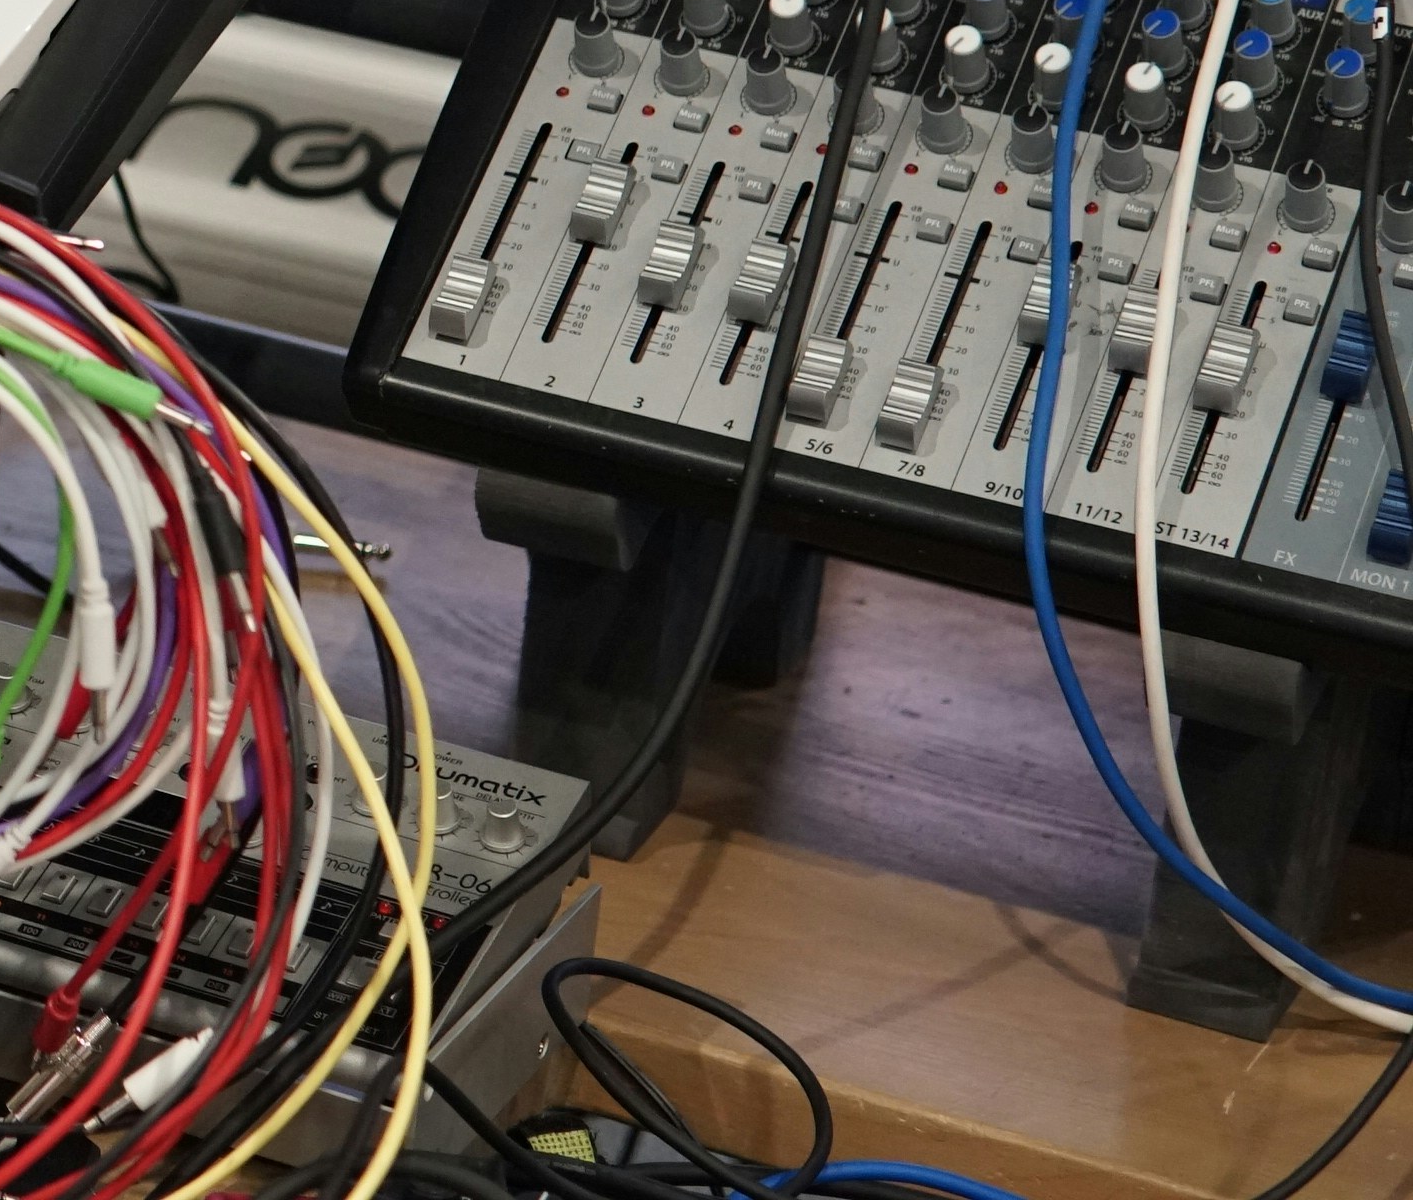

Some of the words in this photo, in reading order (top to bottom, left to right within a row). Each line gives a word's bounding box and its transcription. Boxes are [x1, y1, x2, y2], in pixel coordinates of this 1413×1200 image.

[1297, 7, 1325, 22] AUX
[592, 89, 616, 100] Mute
[679, 108, 701, 121] Mute
[765, 127, 789, 139] Mute
[576, 145, 592, 156] PFL
[853, 145, 877, 157] Mute
[660, 159, 675, 170] PFL
[944, 163, 968, 175] Mute
[746, 180, 762, 190] PFL
[1124, 202, 1149, 215] Mute
[925, 217, 941, 228] PFL
[1215, 224, 1241, 237] Mute
[1018, 241, 1035, 252] PFL
[1308, 243, 1334, 256] Mute
[1108, 257, 1124, 268] PFL
[1199, 277, 1216, 289] PFL
[1294, 299, 1312, 310] PFL
[459, 354, 467, 366] 1
[544, 375, 556, 388] 2
[633, 397, 645, 409] 3
[723, 419, 735, 431] 4
[804, 438, 833, 455] 5/6
[897, 460, 926, 477] 7/8
[984, 481, 1023, 500] 9/10
[1074, 502, 1124, 525] 11/12
[1155, 521, 1178, 537] ST
[1182, 528, 1230, 550] 13/14
[1273, 550, 1298, 567] FX
[1350, 568, 1397, 590] MON
[28, 676, 45, 685] TOM
[402, 753, 546, 806] Dumatix
[431, 863, 492, 895] R-06
[22, 925, 39, 936] 100
[67, 938, 85, 949] 200
